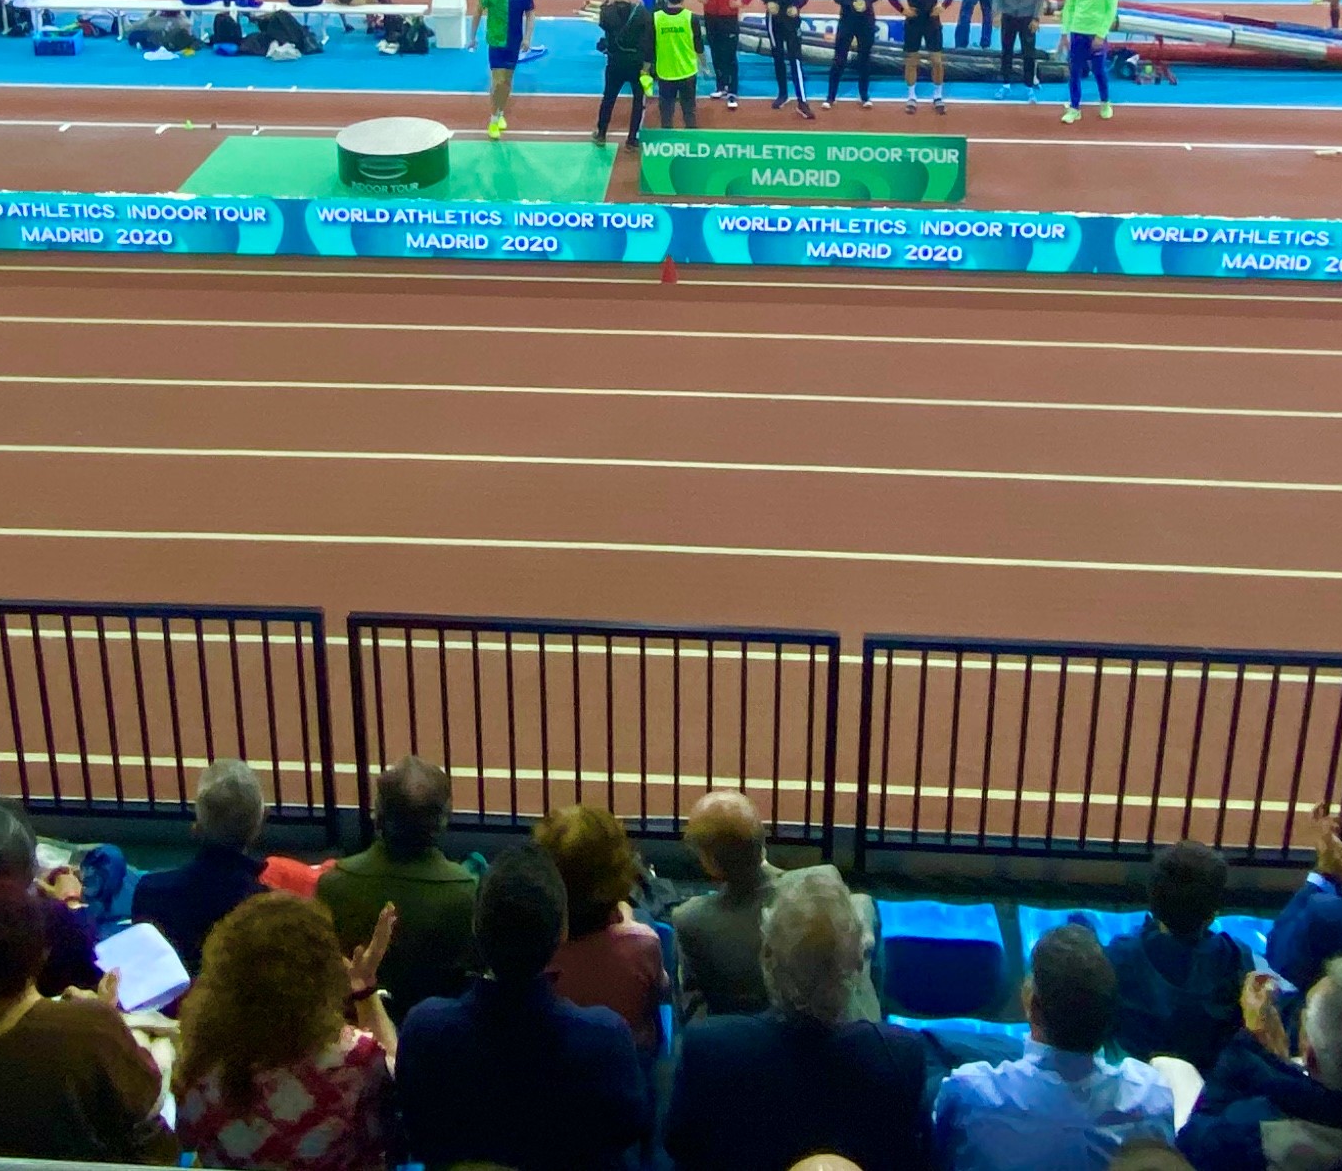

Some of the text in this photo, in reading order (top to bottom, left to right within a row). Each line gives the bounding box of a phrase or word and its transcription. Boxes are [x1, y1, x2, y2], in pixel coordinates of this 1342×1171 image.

[641, 142, 959, 164] WORLD ATHLETICS INDOOR TOUR
[751, 168, 840, 187] MADRID
[390, 182, 419, 193] TOUR
[7, 202, 114, 219] ATHLETICS
[127, 204, 207, 220] INDOOR
[211, 206, 266, 221] TOUR
[316, 207, 654, 229] WORLD ATHLETICS INDOOR TOUR
[21, 226, 173, 245] MADRID 2020
[717, 215, 1065, 239] WORLD ATHLETICS INDOOR TOUR
[1130, 226, 1209, 243] WORLD
[1211, 228, 1329, 246] ATHLETICS
[406, 233, 558, 252] MADRID 2020
[806, 241, 963, 261] MADRID 2020
[1221, 253, 1311, 271] MADRID
